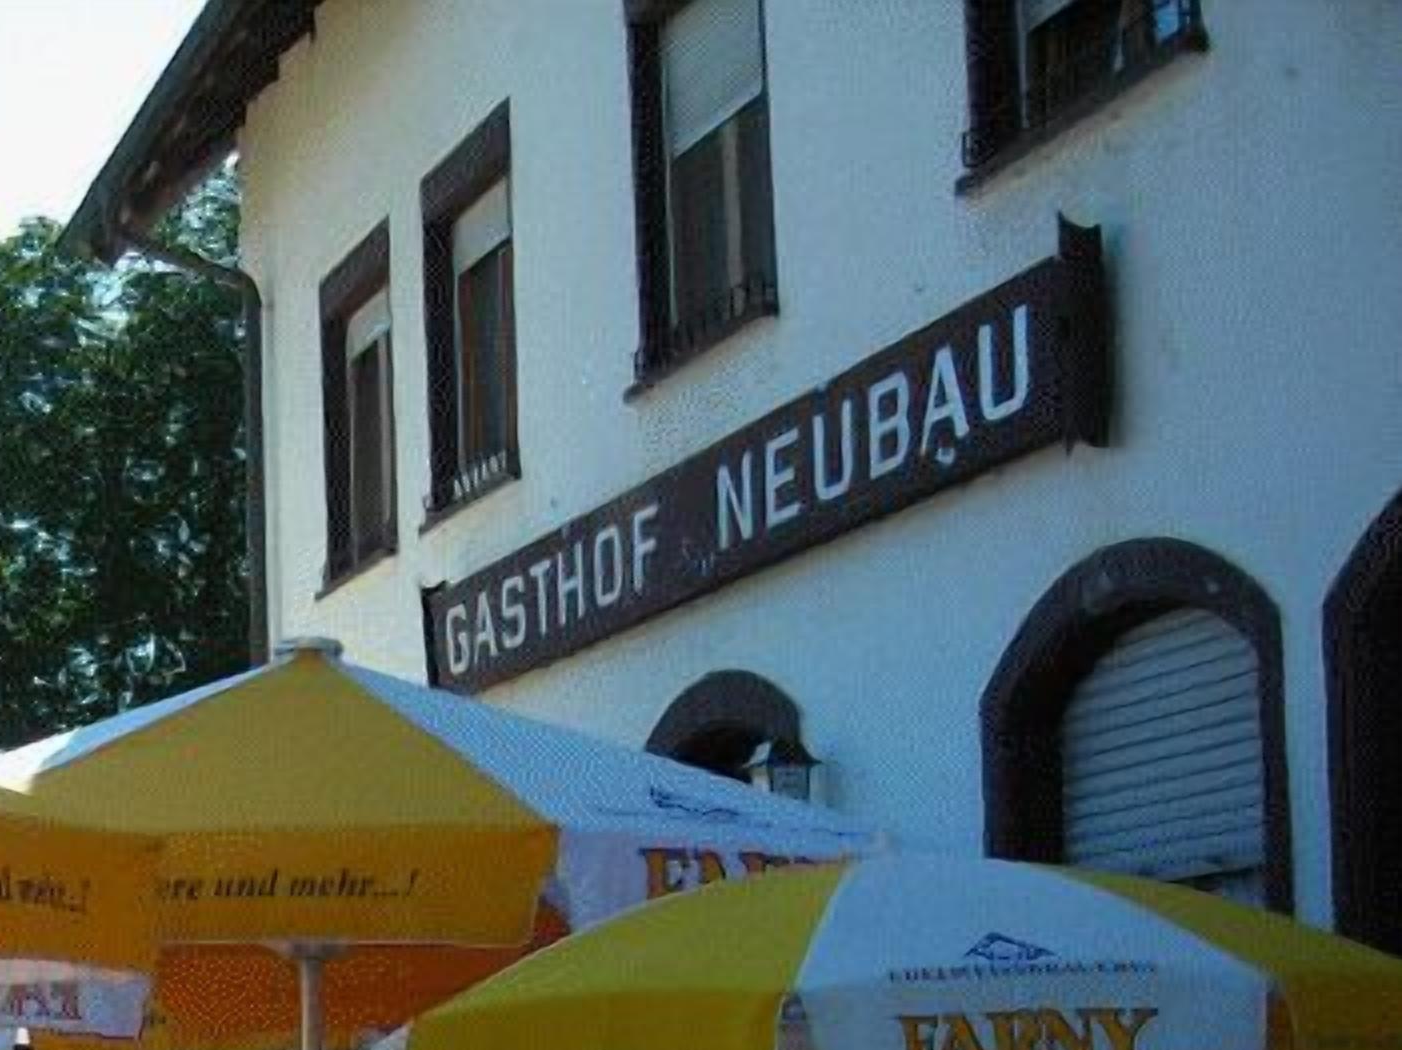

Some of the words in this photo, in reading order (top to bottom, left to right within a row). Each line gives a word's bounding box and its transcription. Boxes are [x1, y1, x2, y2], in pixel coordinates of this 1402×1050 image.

[443, 504, 660, 675] GASTHOF
[715, 304, 1032, 551] NEUBAU
[213, 867, 279, 898] und
